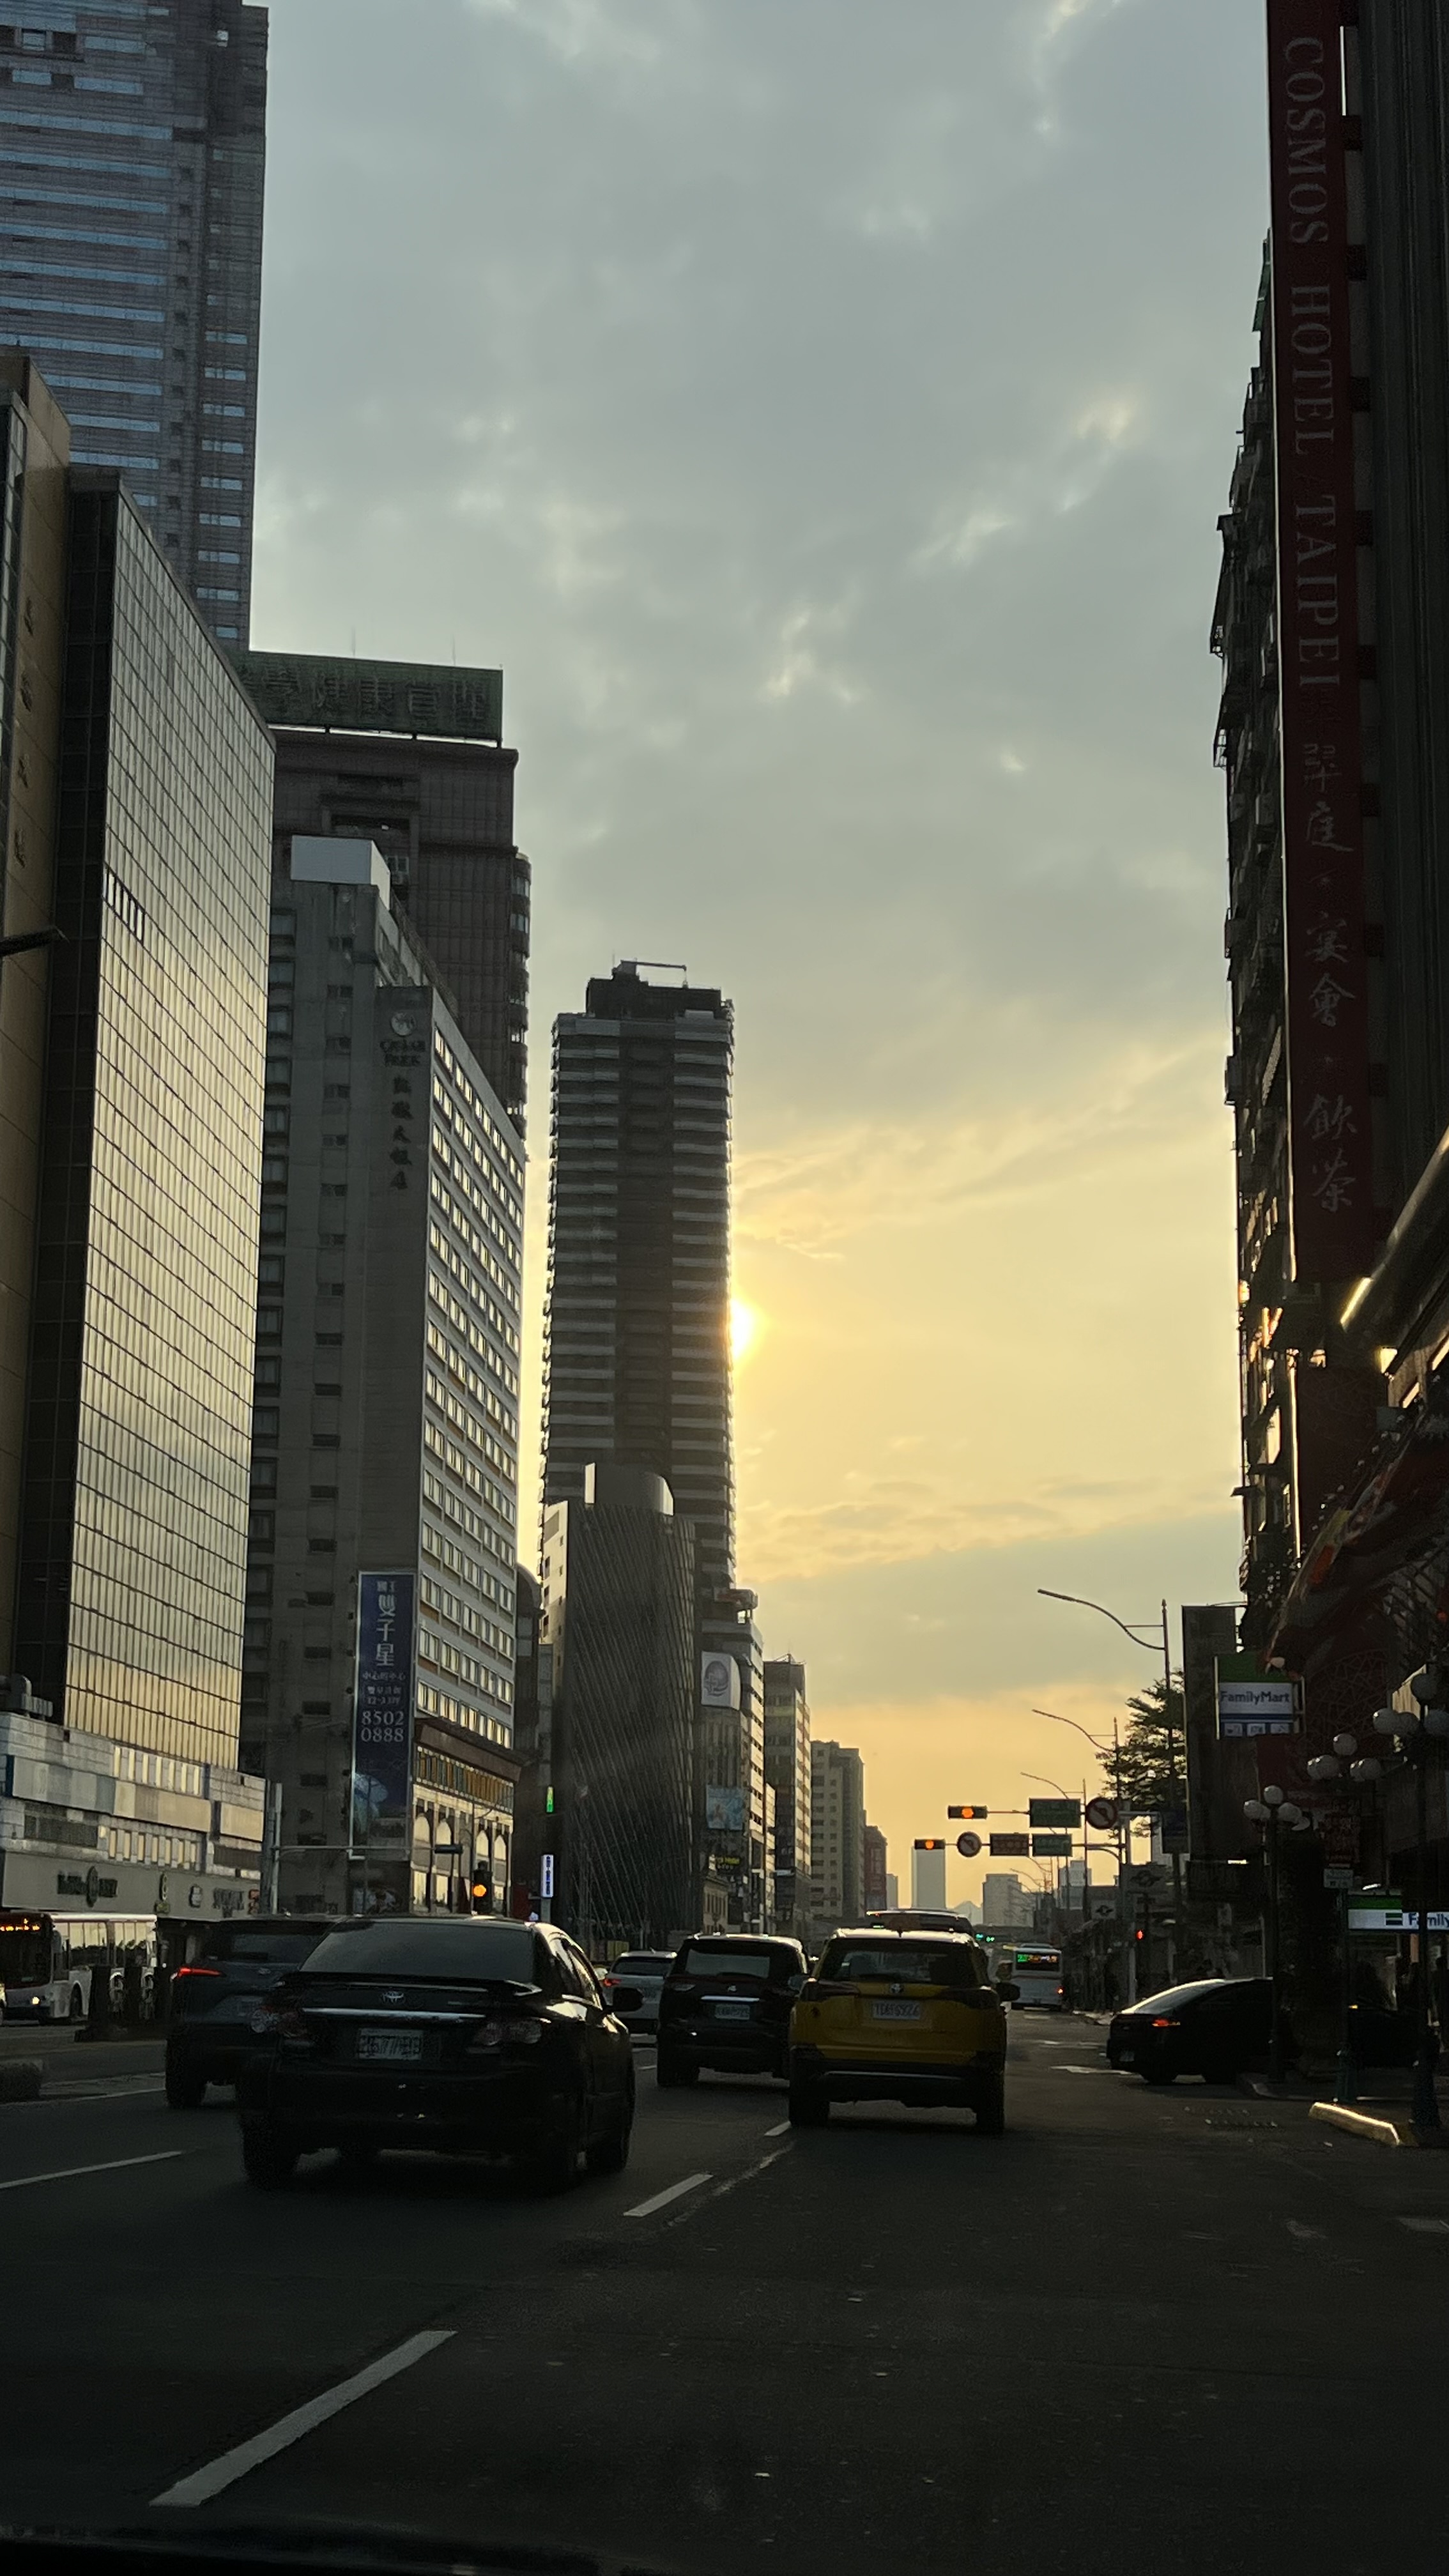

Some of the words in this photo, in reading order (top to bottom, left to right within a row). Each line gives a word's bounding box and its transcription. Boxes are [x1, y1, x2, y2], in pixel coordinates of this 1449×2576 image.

[1285, 37, 1330, 245] COSMOS
[1290, 284, 1334, 456] HOTEL
[1295, 494, 1341, 686] TAIPEI
[360, 1727, 404, 1743] 0888
[362, 1710, 404, 1726] 8502
[1220, 1690, 1290, 1705] FamilyMart
